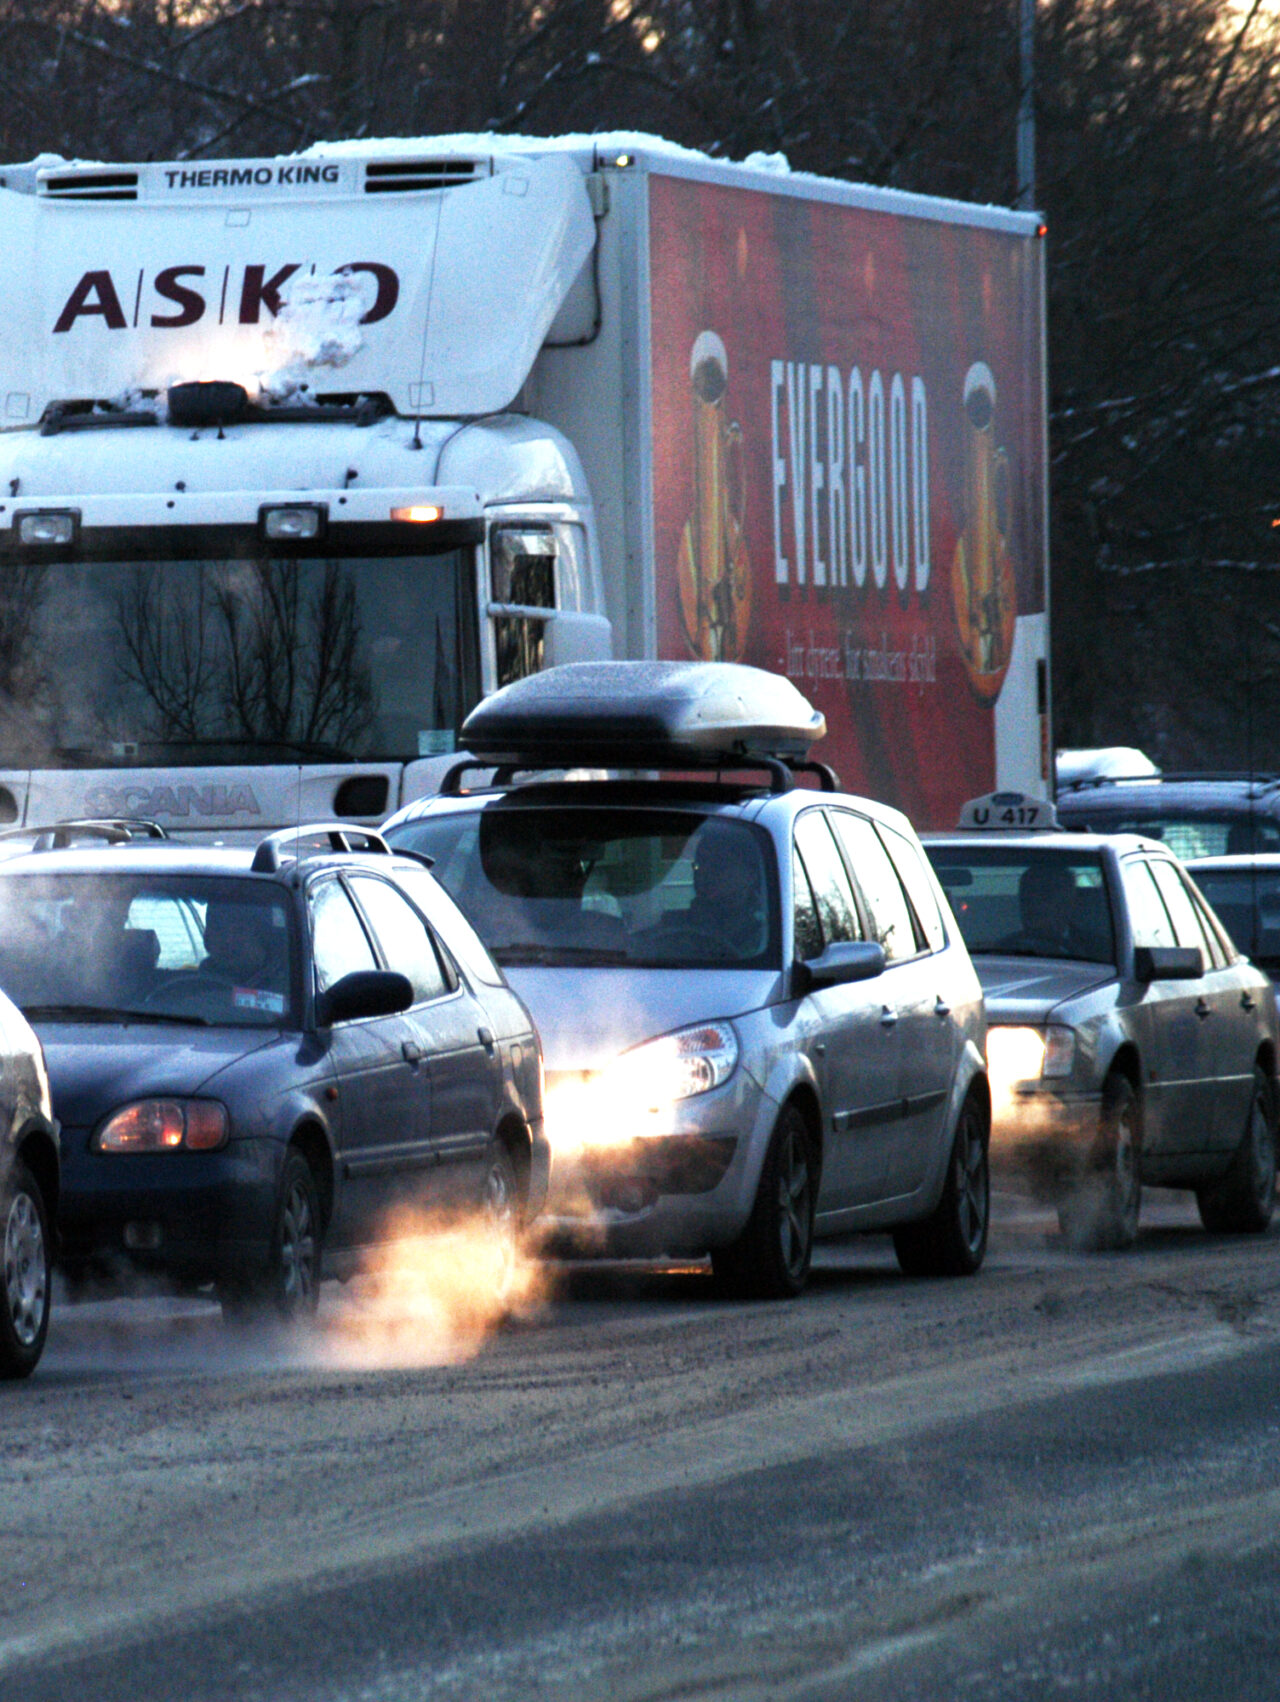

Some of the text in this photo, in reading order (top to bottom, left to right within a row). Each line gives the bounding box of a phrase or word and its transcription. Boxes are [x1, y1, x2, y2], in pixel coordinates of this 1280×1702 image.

[165, 165, 339, 189] THERMO KING
[771, 359, 930, 591] EVERGOOD
[84, 785, 261, 816] SCANIA
[973, 807, 1039, 824] U 417
